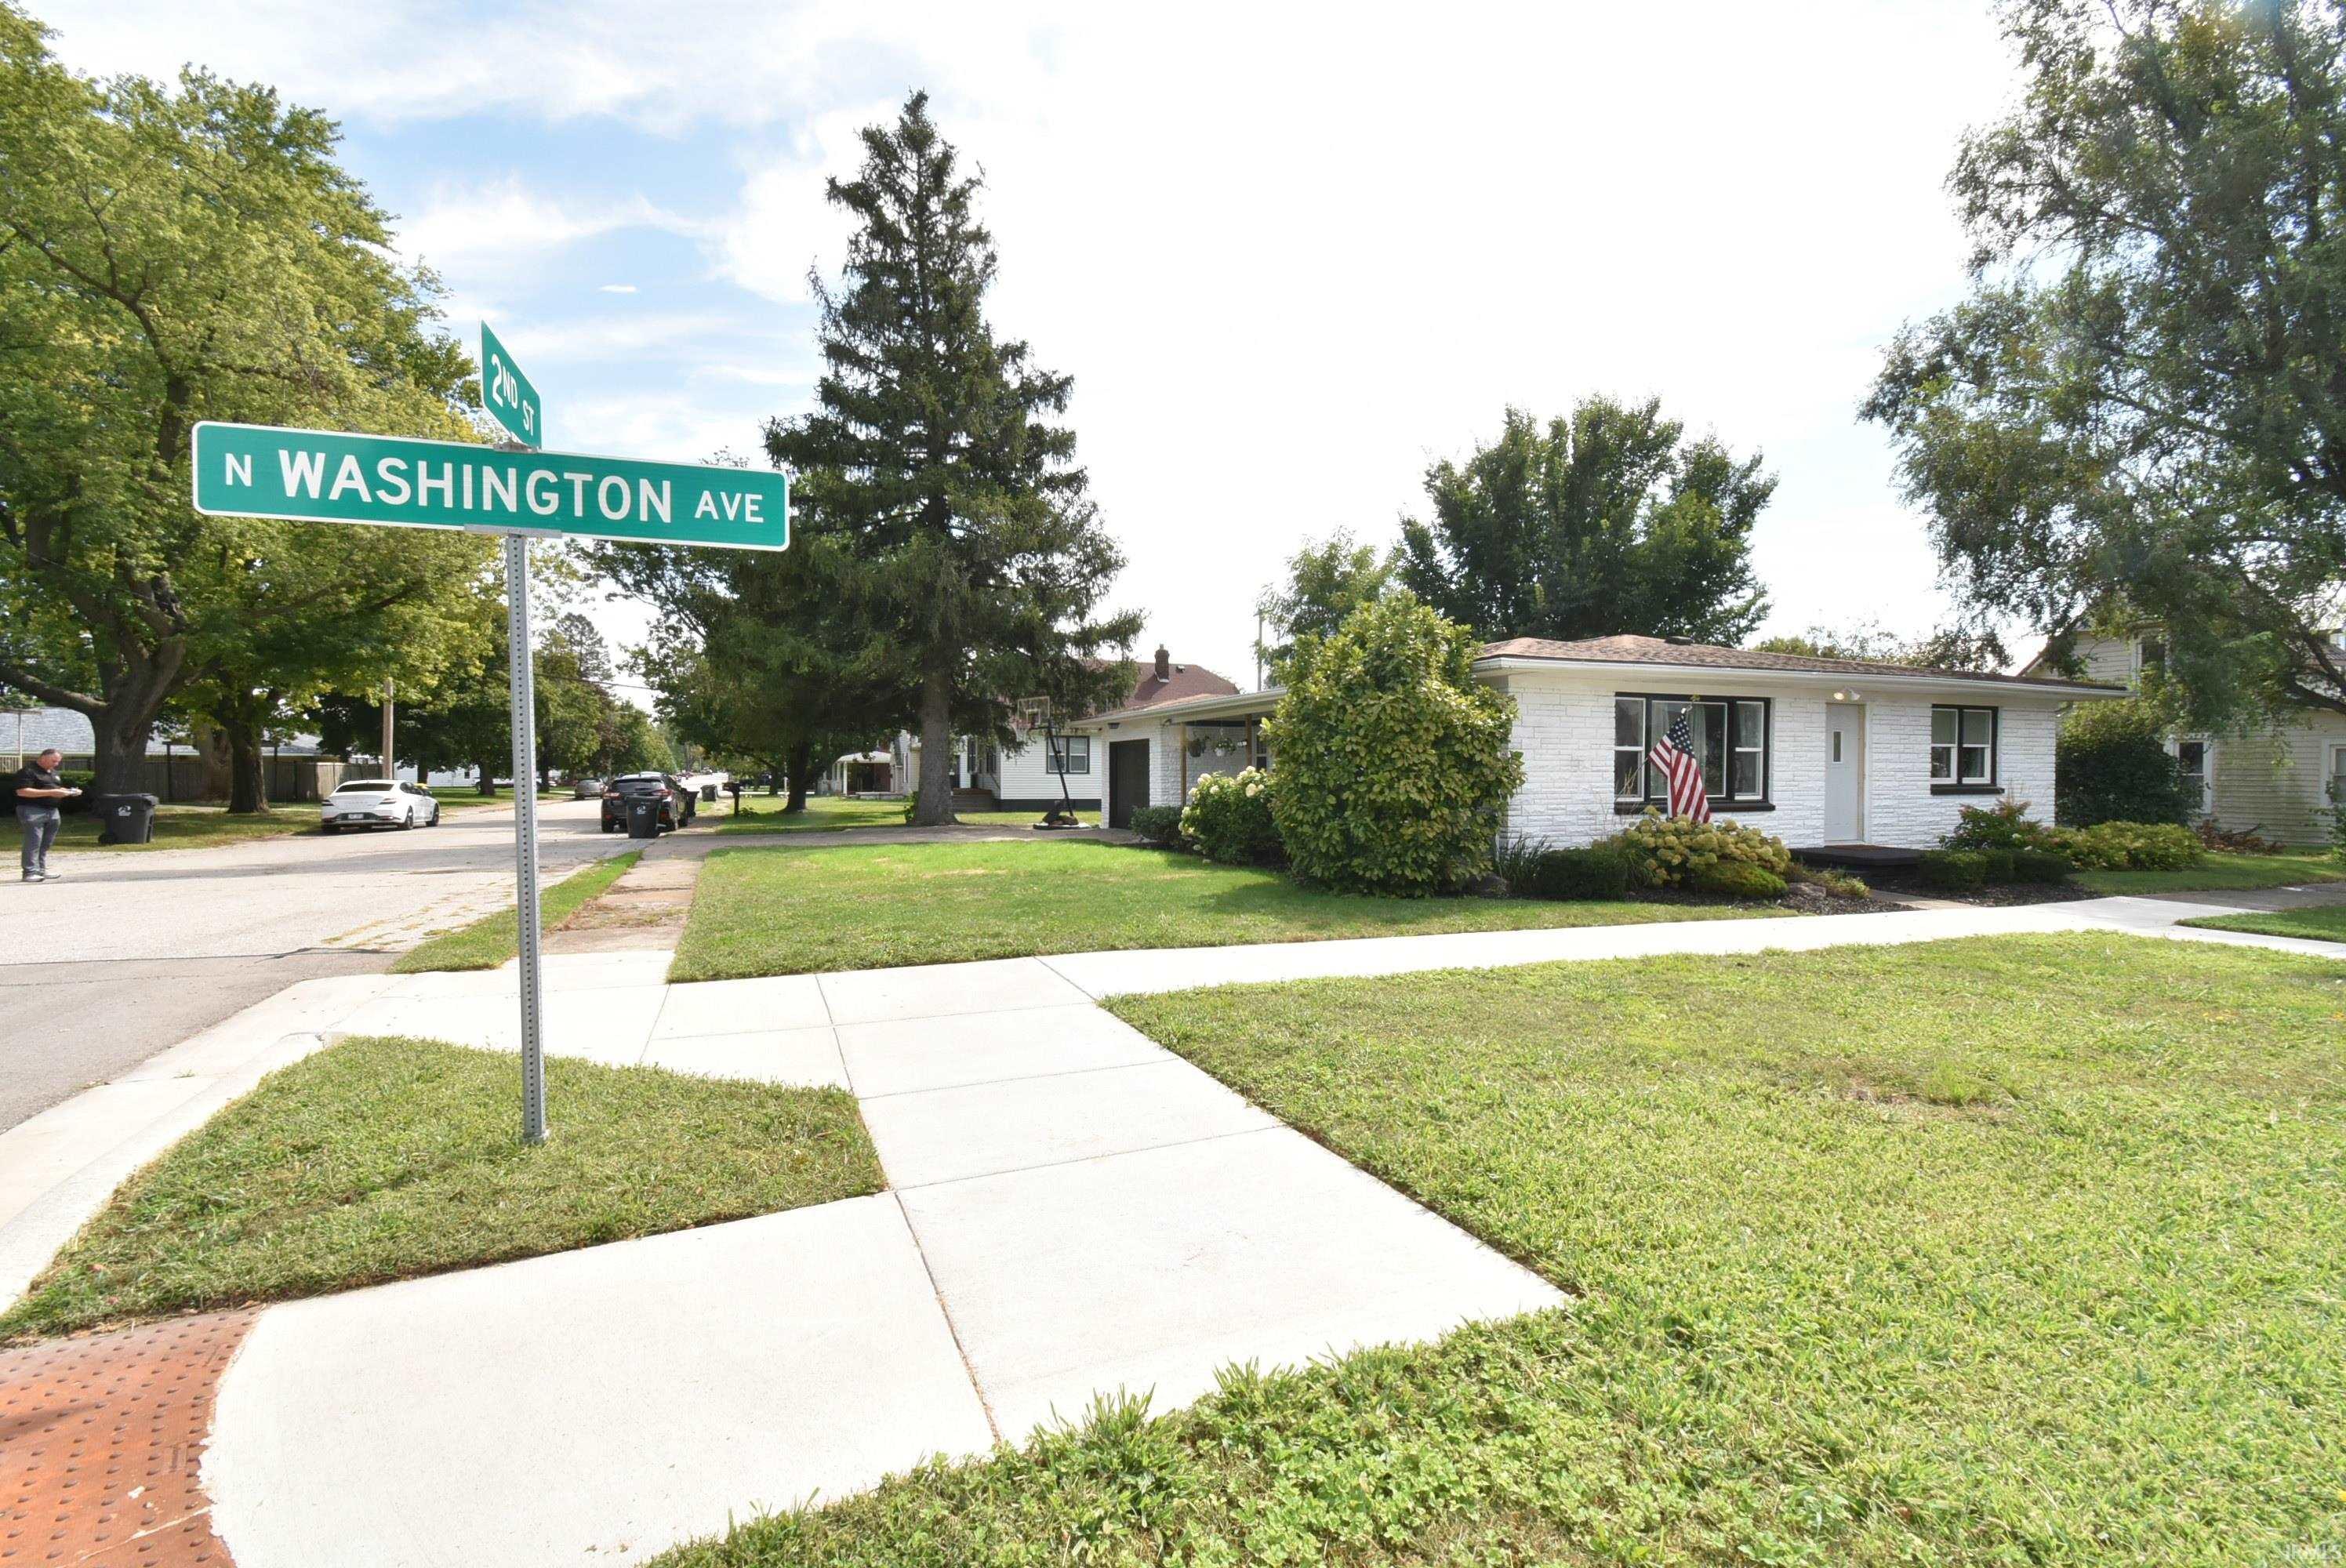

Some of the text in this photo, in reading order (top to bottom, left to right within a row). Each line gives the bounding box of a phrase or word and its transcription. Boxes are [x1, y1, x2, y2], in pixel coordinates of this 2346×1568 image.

[491, 353, 535, 437] 2ND ST
[225, 449, 764, 523] N WASHINGTON AVE
